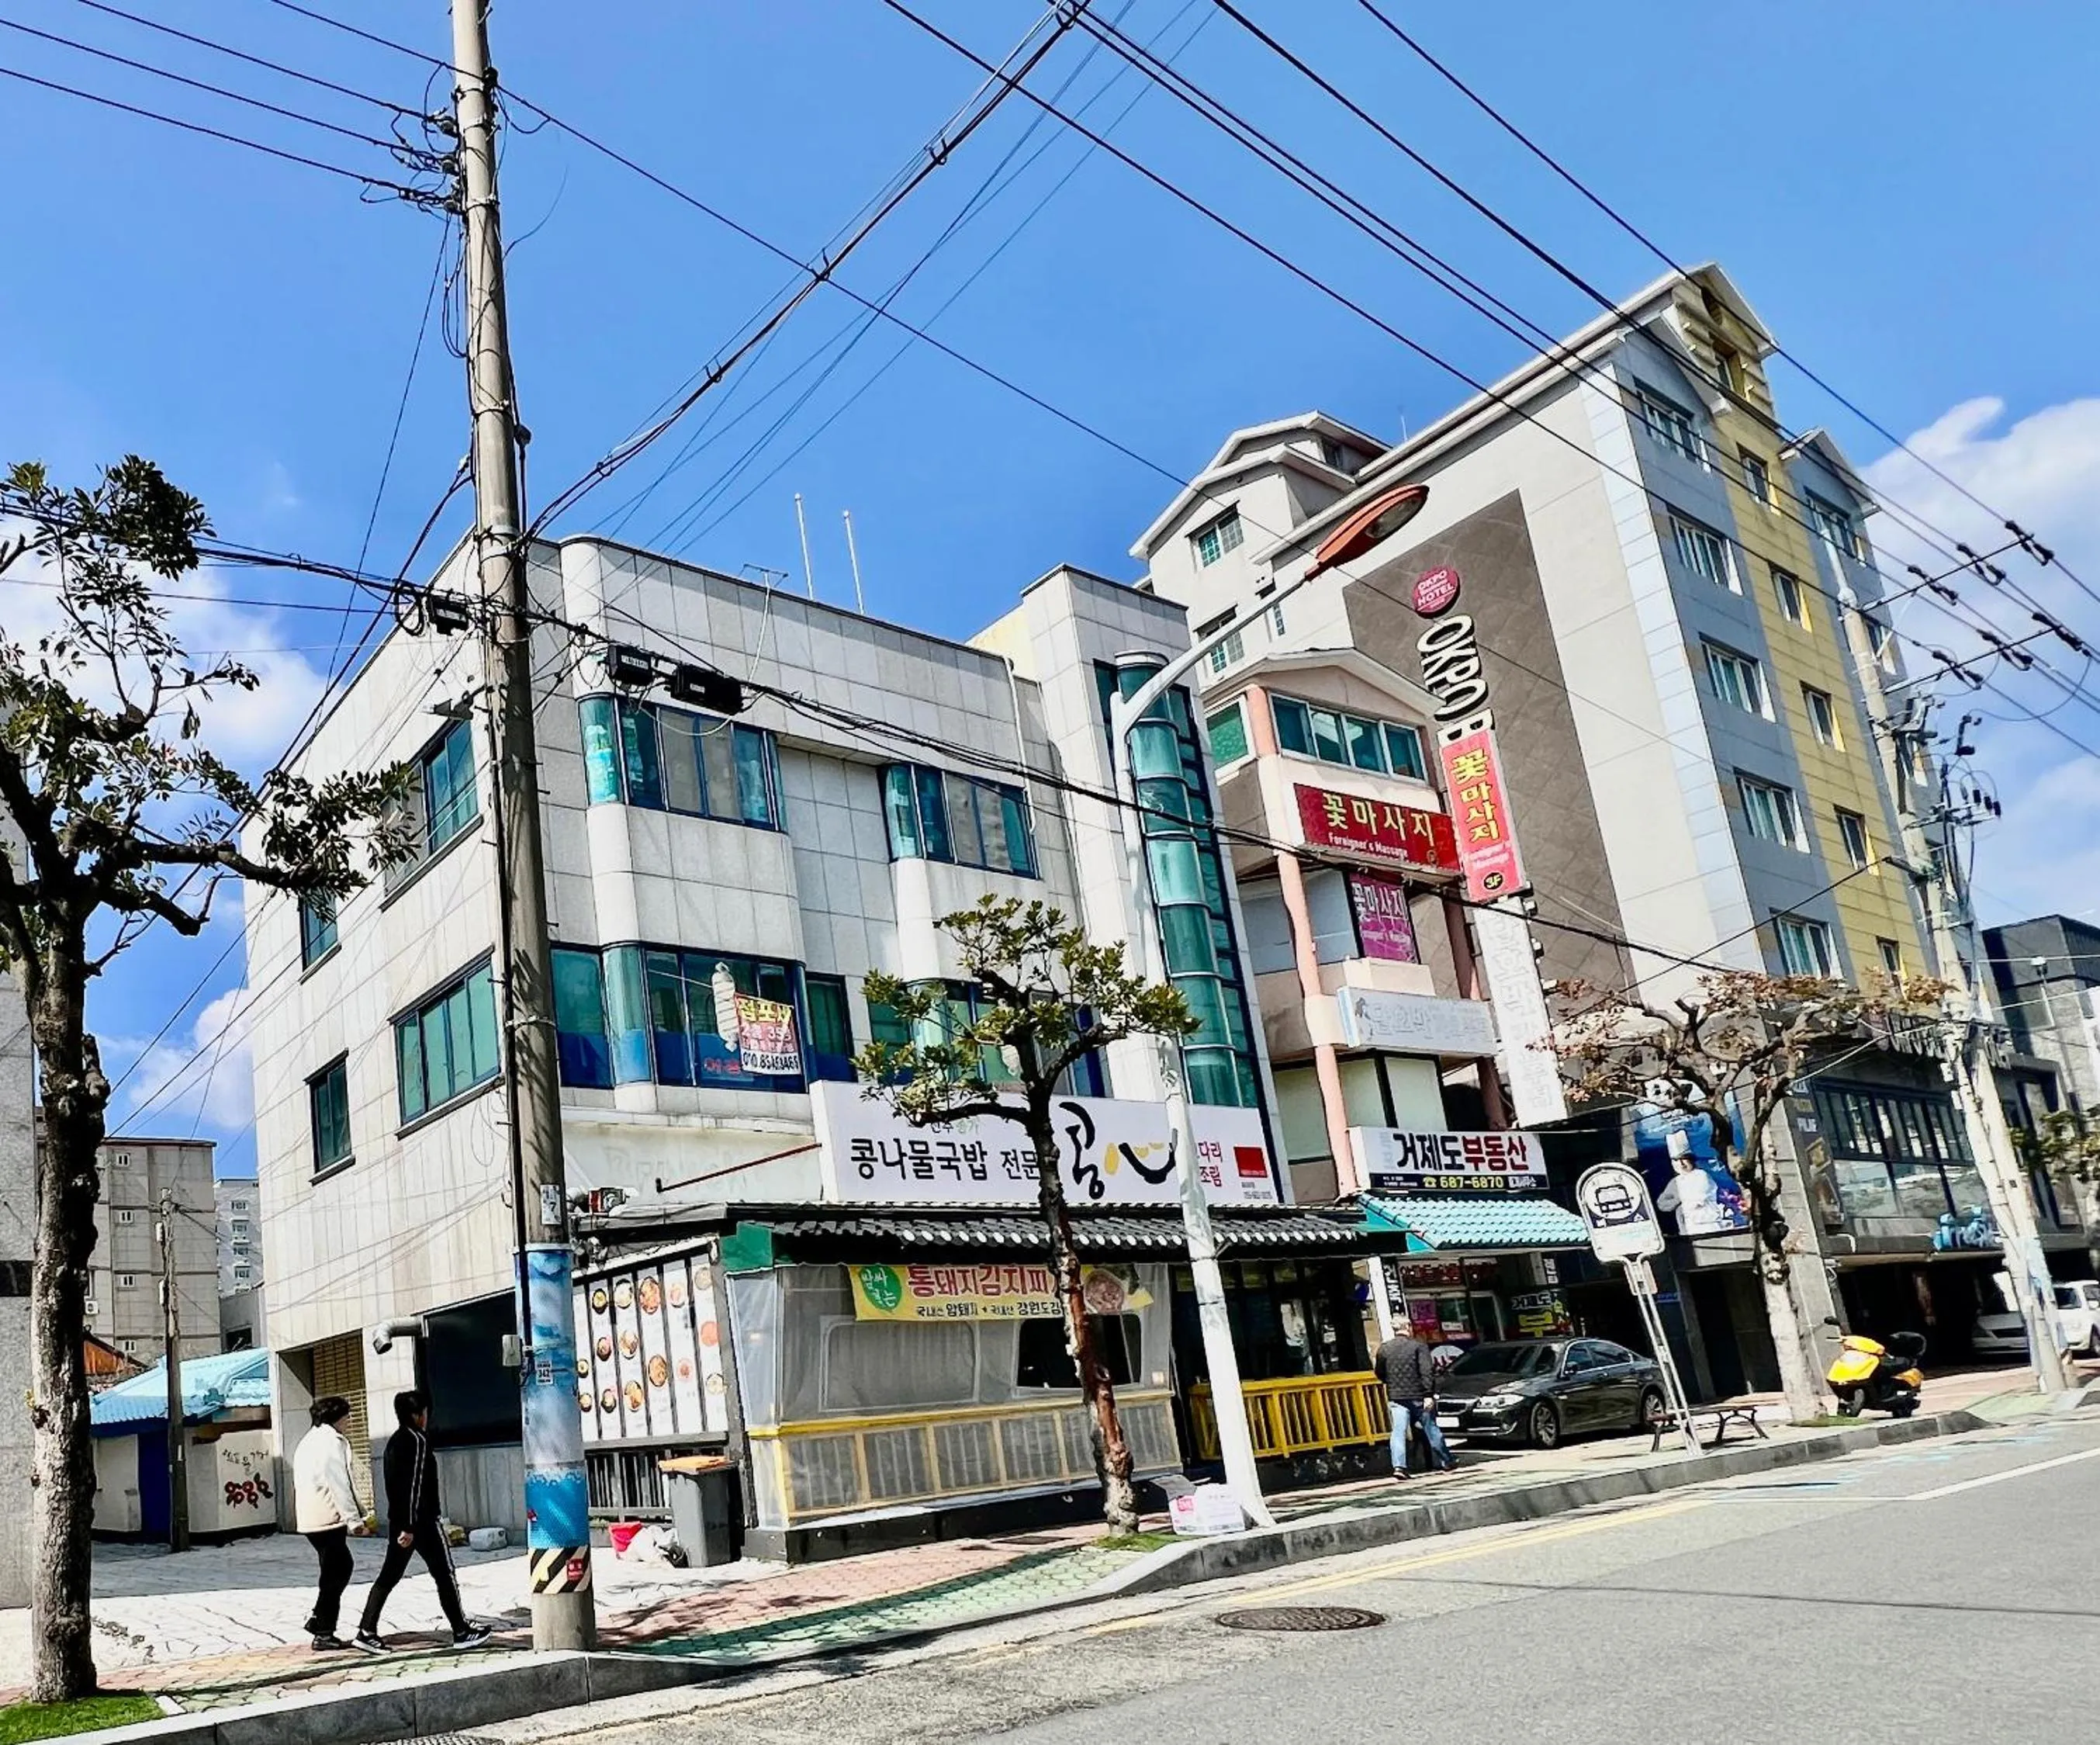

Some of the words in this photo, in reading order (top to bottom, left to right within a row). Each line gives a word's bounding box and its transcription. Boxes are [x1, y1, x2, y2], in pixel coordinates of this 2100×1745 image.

[1417, 583, 1455, 607] HOTEL
[1450, 747, 1501, 843] 꽃마사지
[1323, 791, 1434, 847] 꽃마사지
[850, 1137, 988, 1181] 콩나물국밥
[1197, 1140, 1223, 1163] 다리
[1393, 1132, 1530, 1172] 거제도부동산
[907, 1265, 1056, 1297] 통돼지김치찌
[1016, 1301, 1065, 1316] 강원도김
